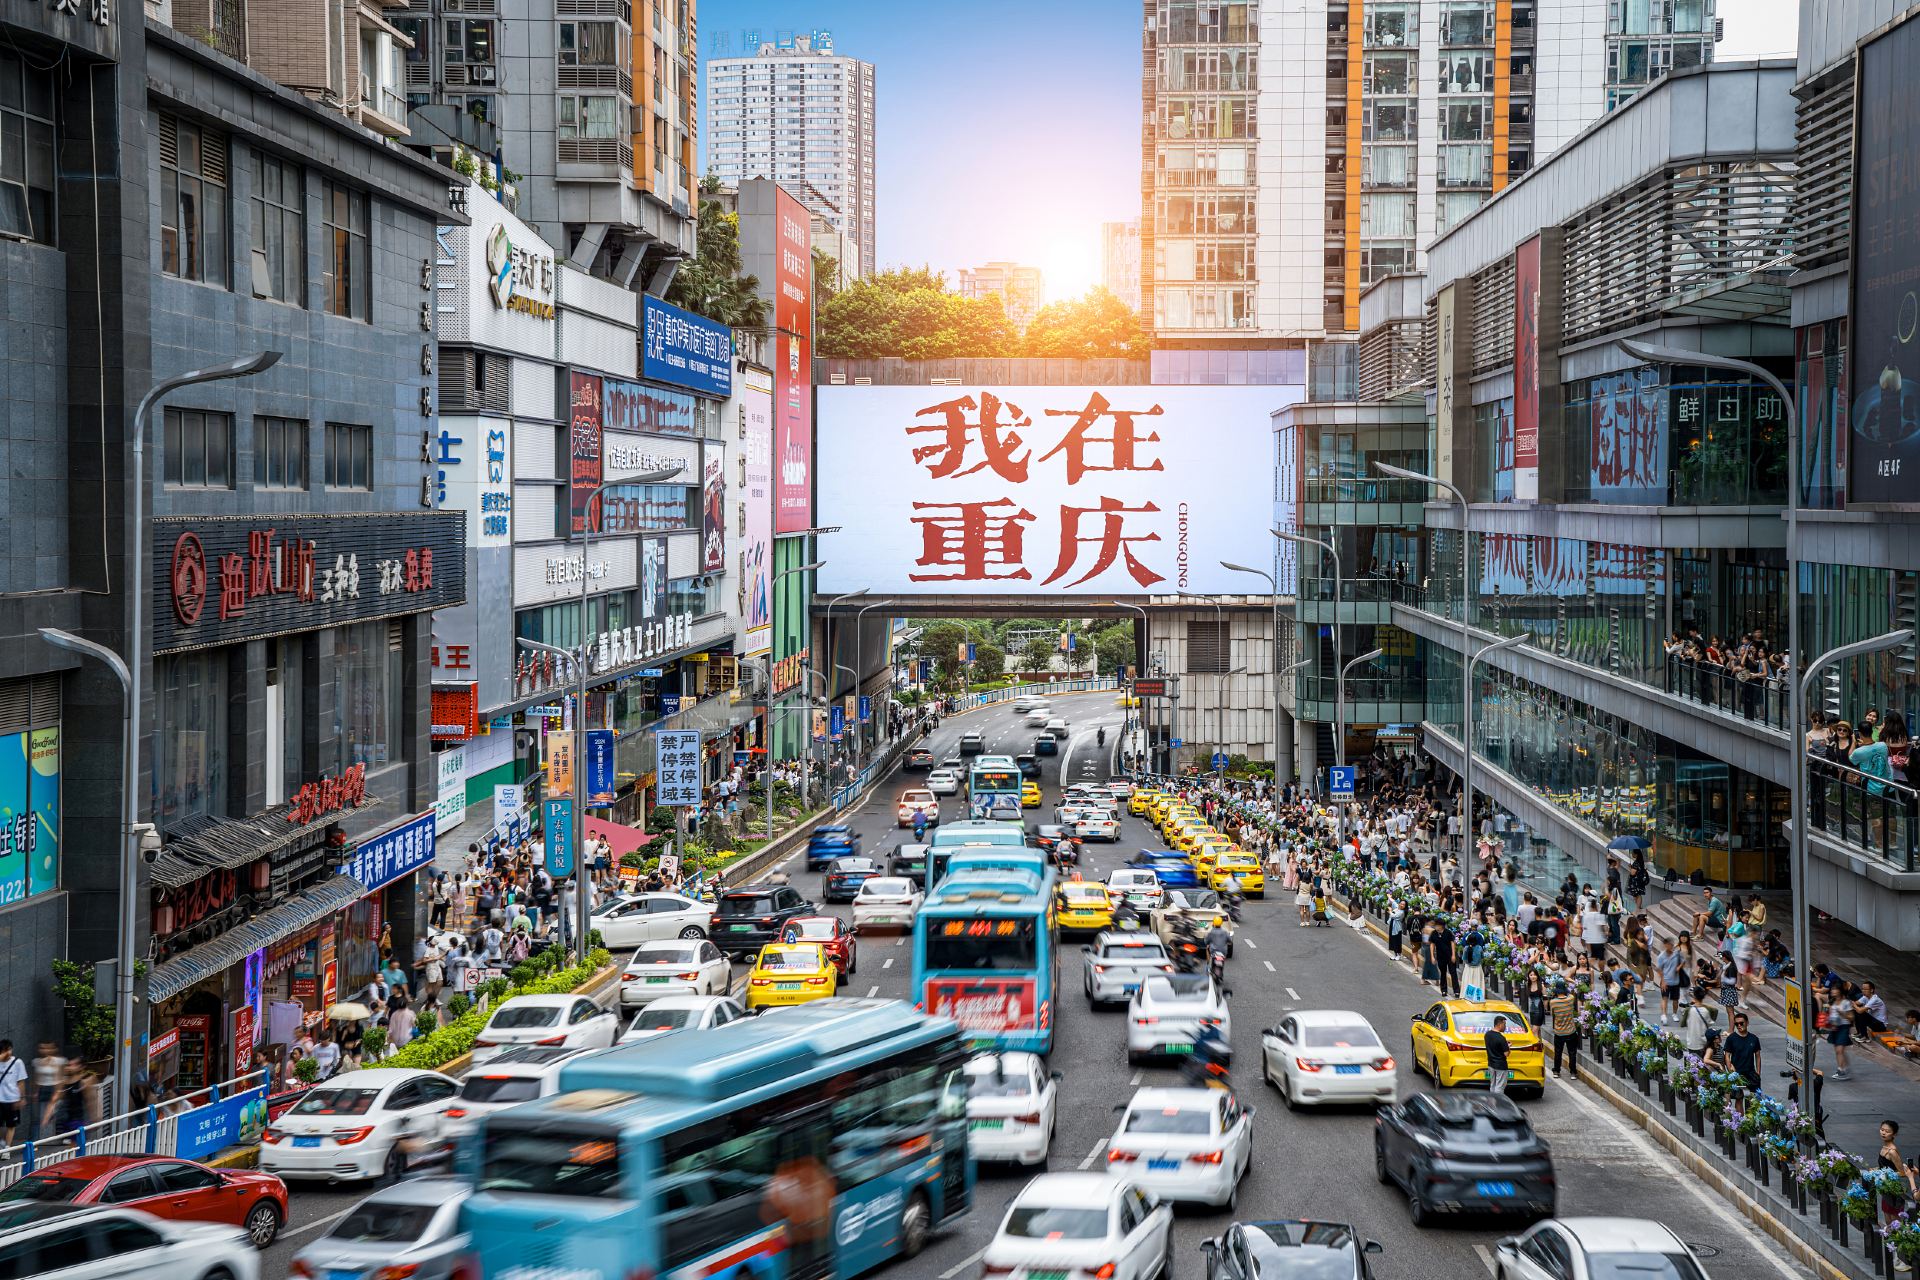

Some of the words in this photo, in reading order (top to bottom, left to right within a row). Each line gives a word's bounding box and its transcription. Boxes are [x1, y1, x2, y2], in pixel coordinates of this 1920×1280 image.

[905, 391, 1165, 486] 我在
[1878, 456, 1901, 483] A区4F
[218, 528, 317, 622] 渔跃山城
[908, 495, 1167, 588] 重庆
[1178, 502, 1188, 588] CHONGQING
[598, 610, 693, 673] 重庆牙卫士口腔医院
[661, 735, 678, 802] 禁停区域
[680, 735, 697, 802] 严禁停车
[1332, 770, 1345, 789] P
[550, 803, 562, 817] P
[354, 821, 434, 886] 重庆特产烟酒超市
